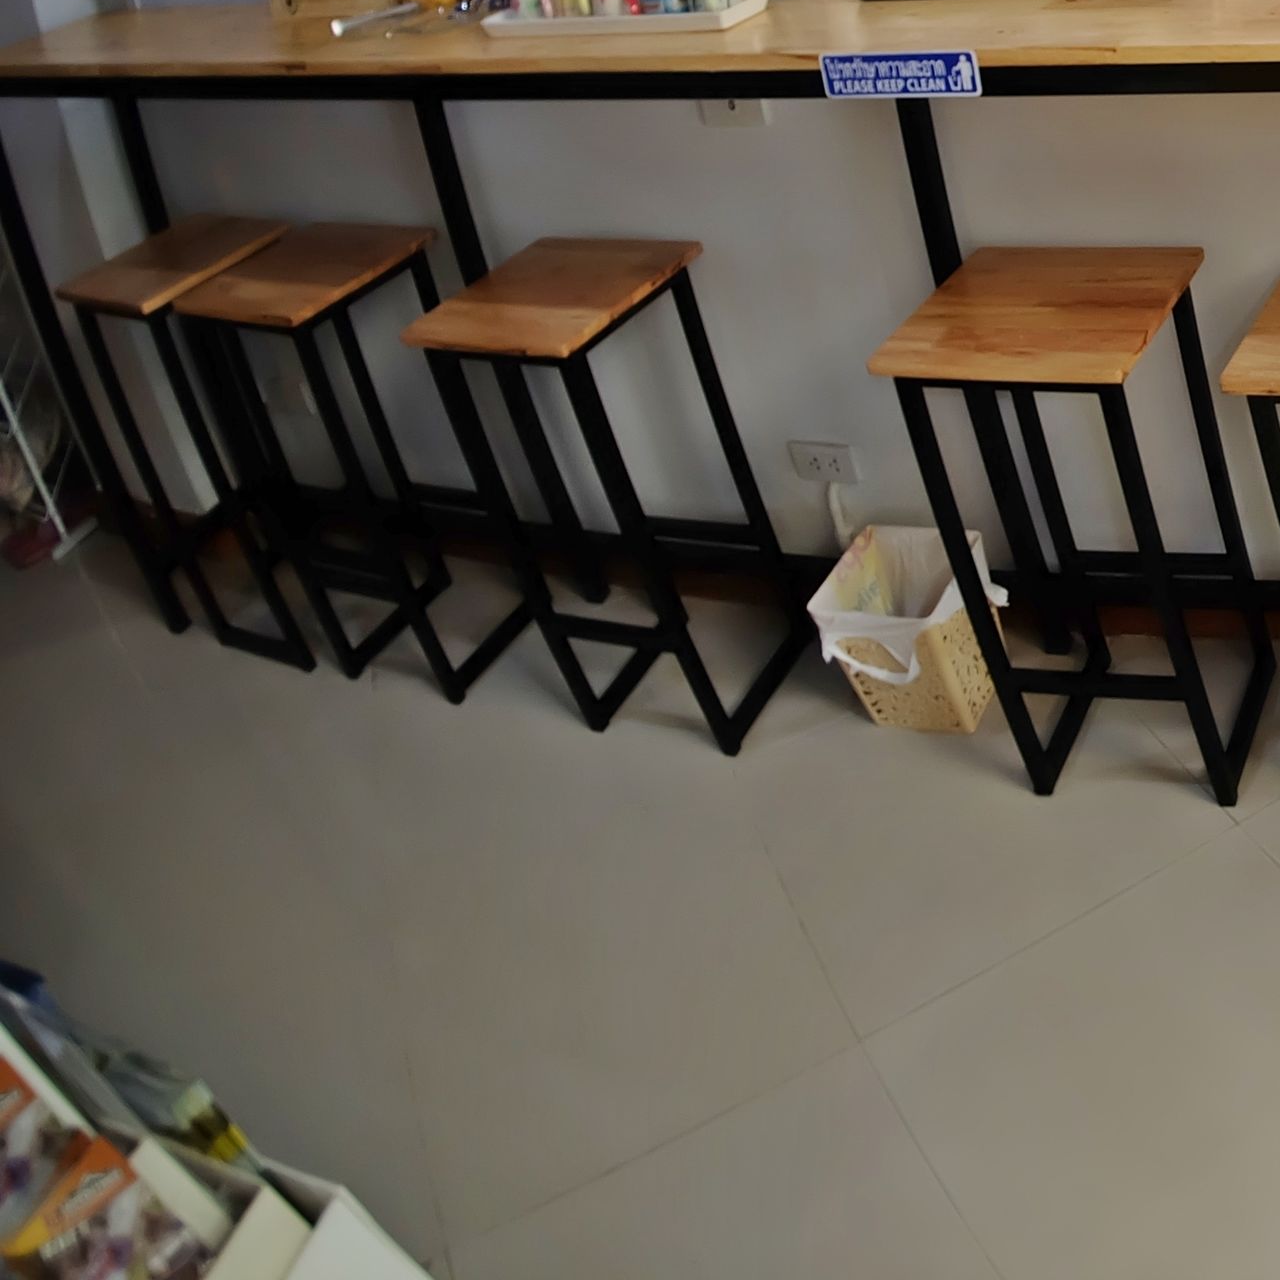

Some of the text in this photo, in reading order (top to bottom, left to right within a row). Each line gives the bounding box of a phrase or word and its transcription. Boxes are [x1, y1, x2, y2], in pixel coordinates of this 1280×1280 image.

[832, 77, 947, 94] PLEASE KEEP CLEAN
